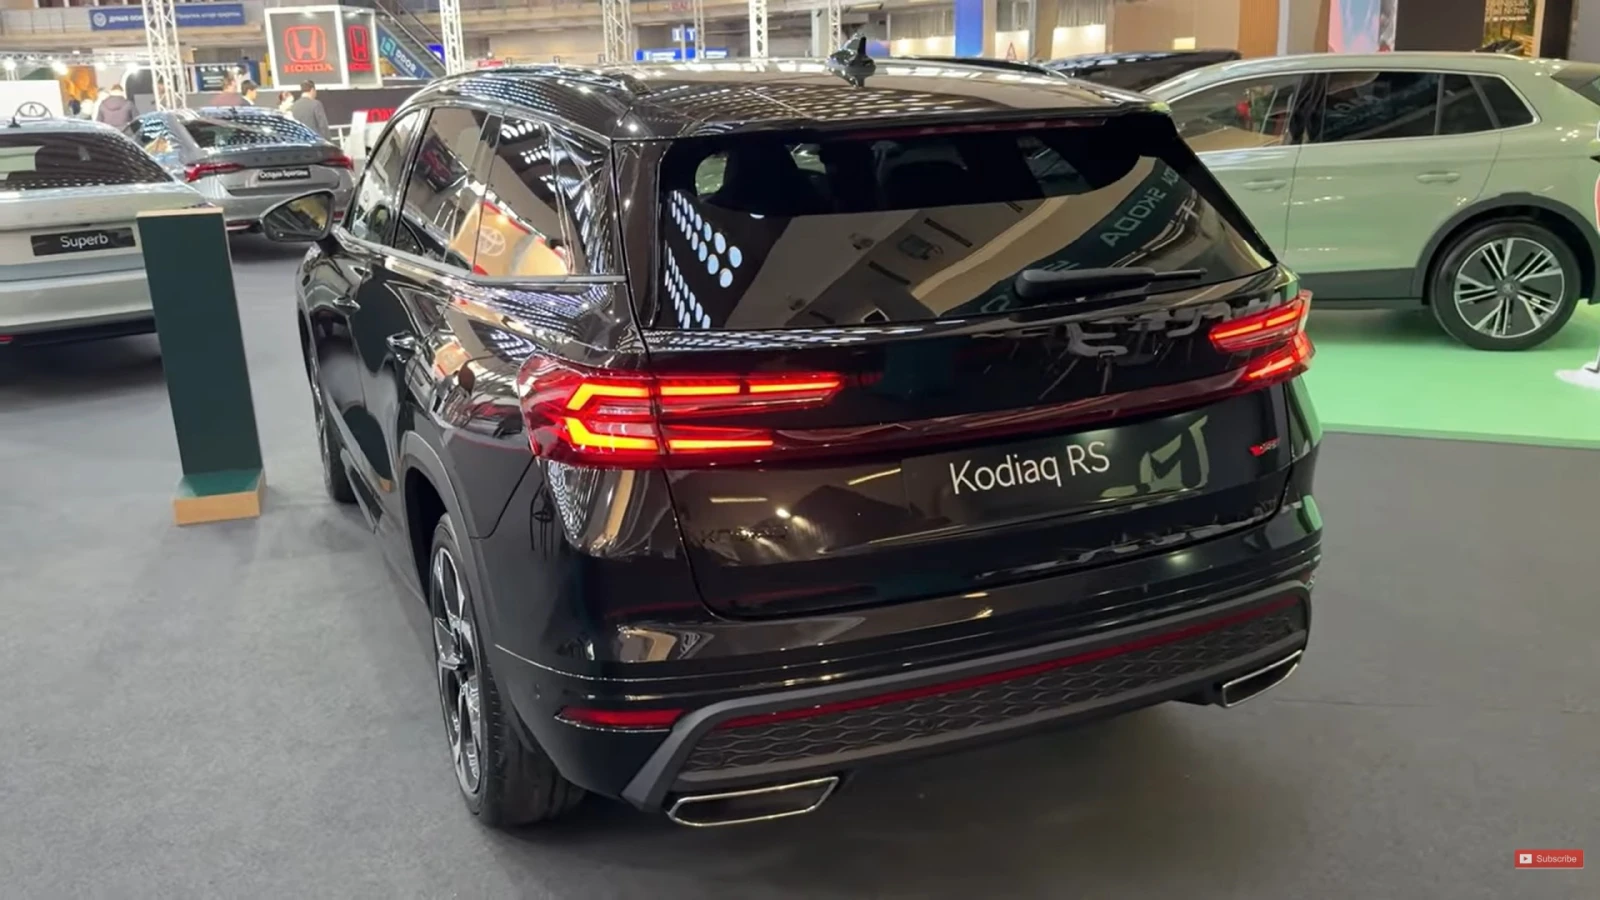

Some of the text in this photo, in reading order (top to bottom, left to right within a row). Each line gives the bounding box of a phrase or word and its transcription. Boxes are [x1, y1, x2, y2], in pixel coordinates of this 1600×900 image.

[284, 63, 334, 73] HONDA
[60, 233, 109, 249] Superb
[949, 441, 1111, 495] Kodiaq RS
